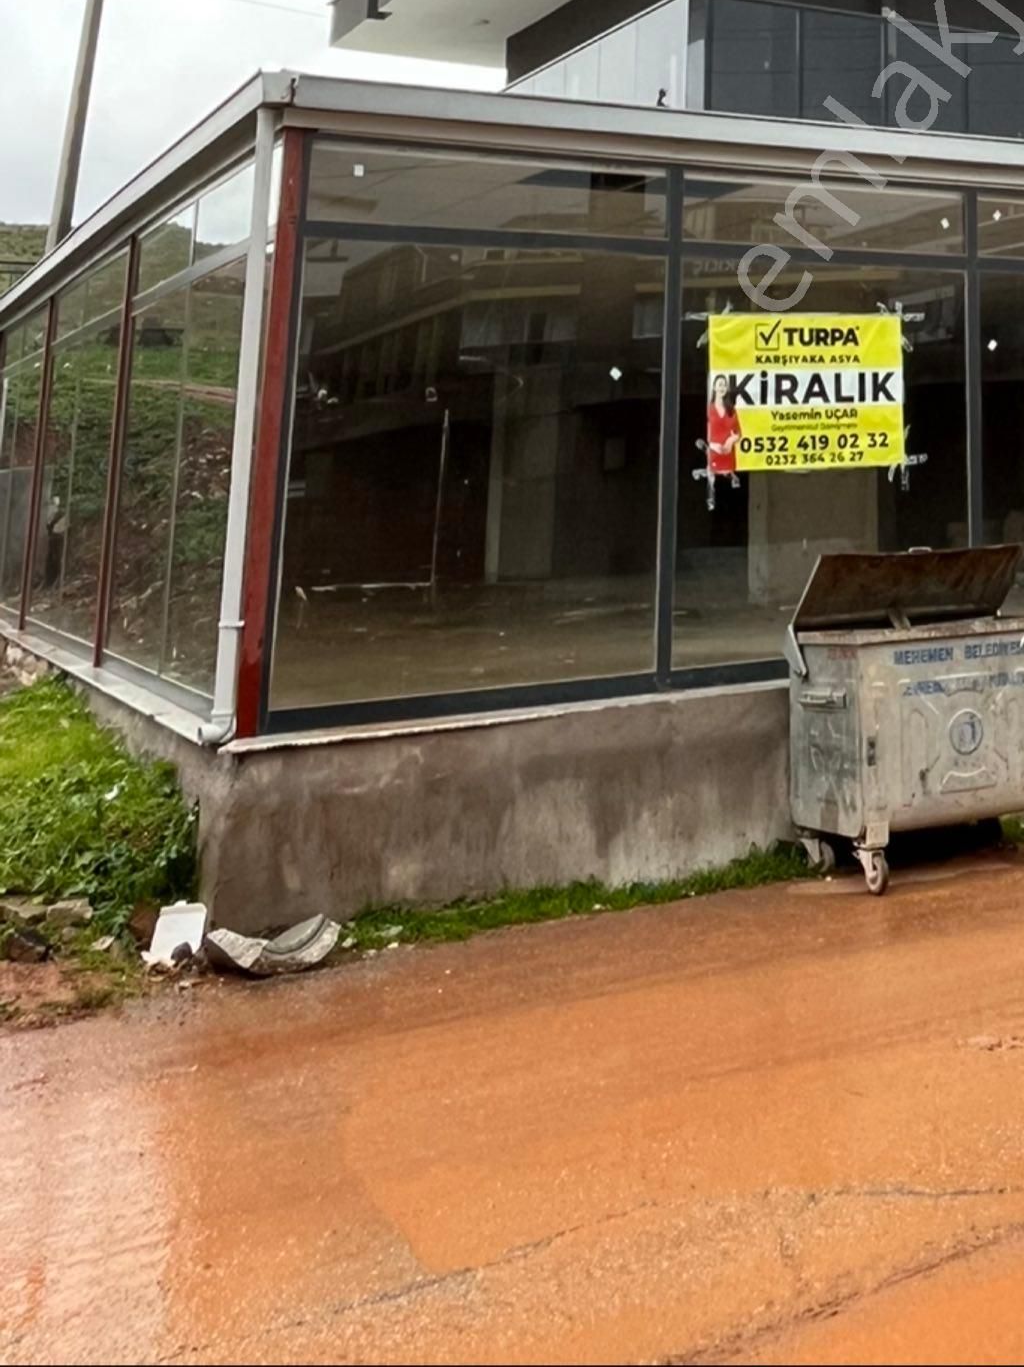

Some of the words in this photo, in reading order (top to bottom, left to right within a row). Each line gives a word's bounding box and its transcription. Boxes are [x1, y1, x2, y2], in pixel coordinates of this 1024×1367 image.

[783, 326, 859, 347] TURPA
[755, 354, 825, 367] KARŞIYAKA
[829, 354, 861, 364] ASYA
[771, 408, 822, 421] Yasemin
[824, 407, 858, 423] UÇAR
[740, 436, 789, 454] 0532
[796, 434, 829, 451] 419
[837, 433, 860, 449] 02
[867, 432, 890, 448] 32
[766, 454, 797, 466] 0232
[801, 452, 825, 464] 364
[830, 451, 845, 463] 26
[850, 451, 864, 462] 27
